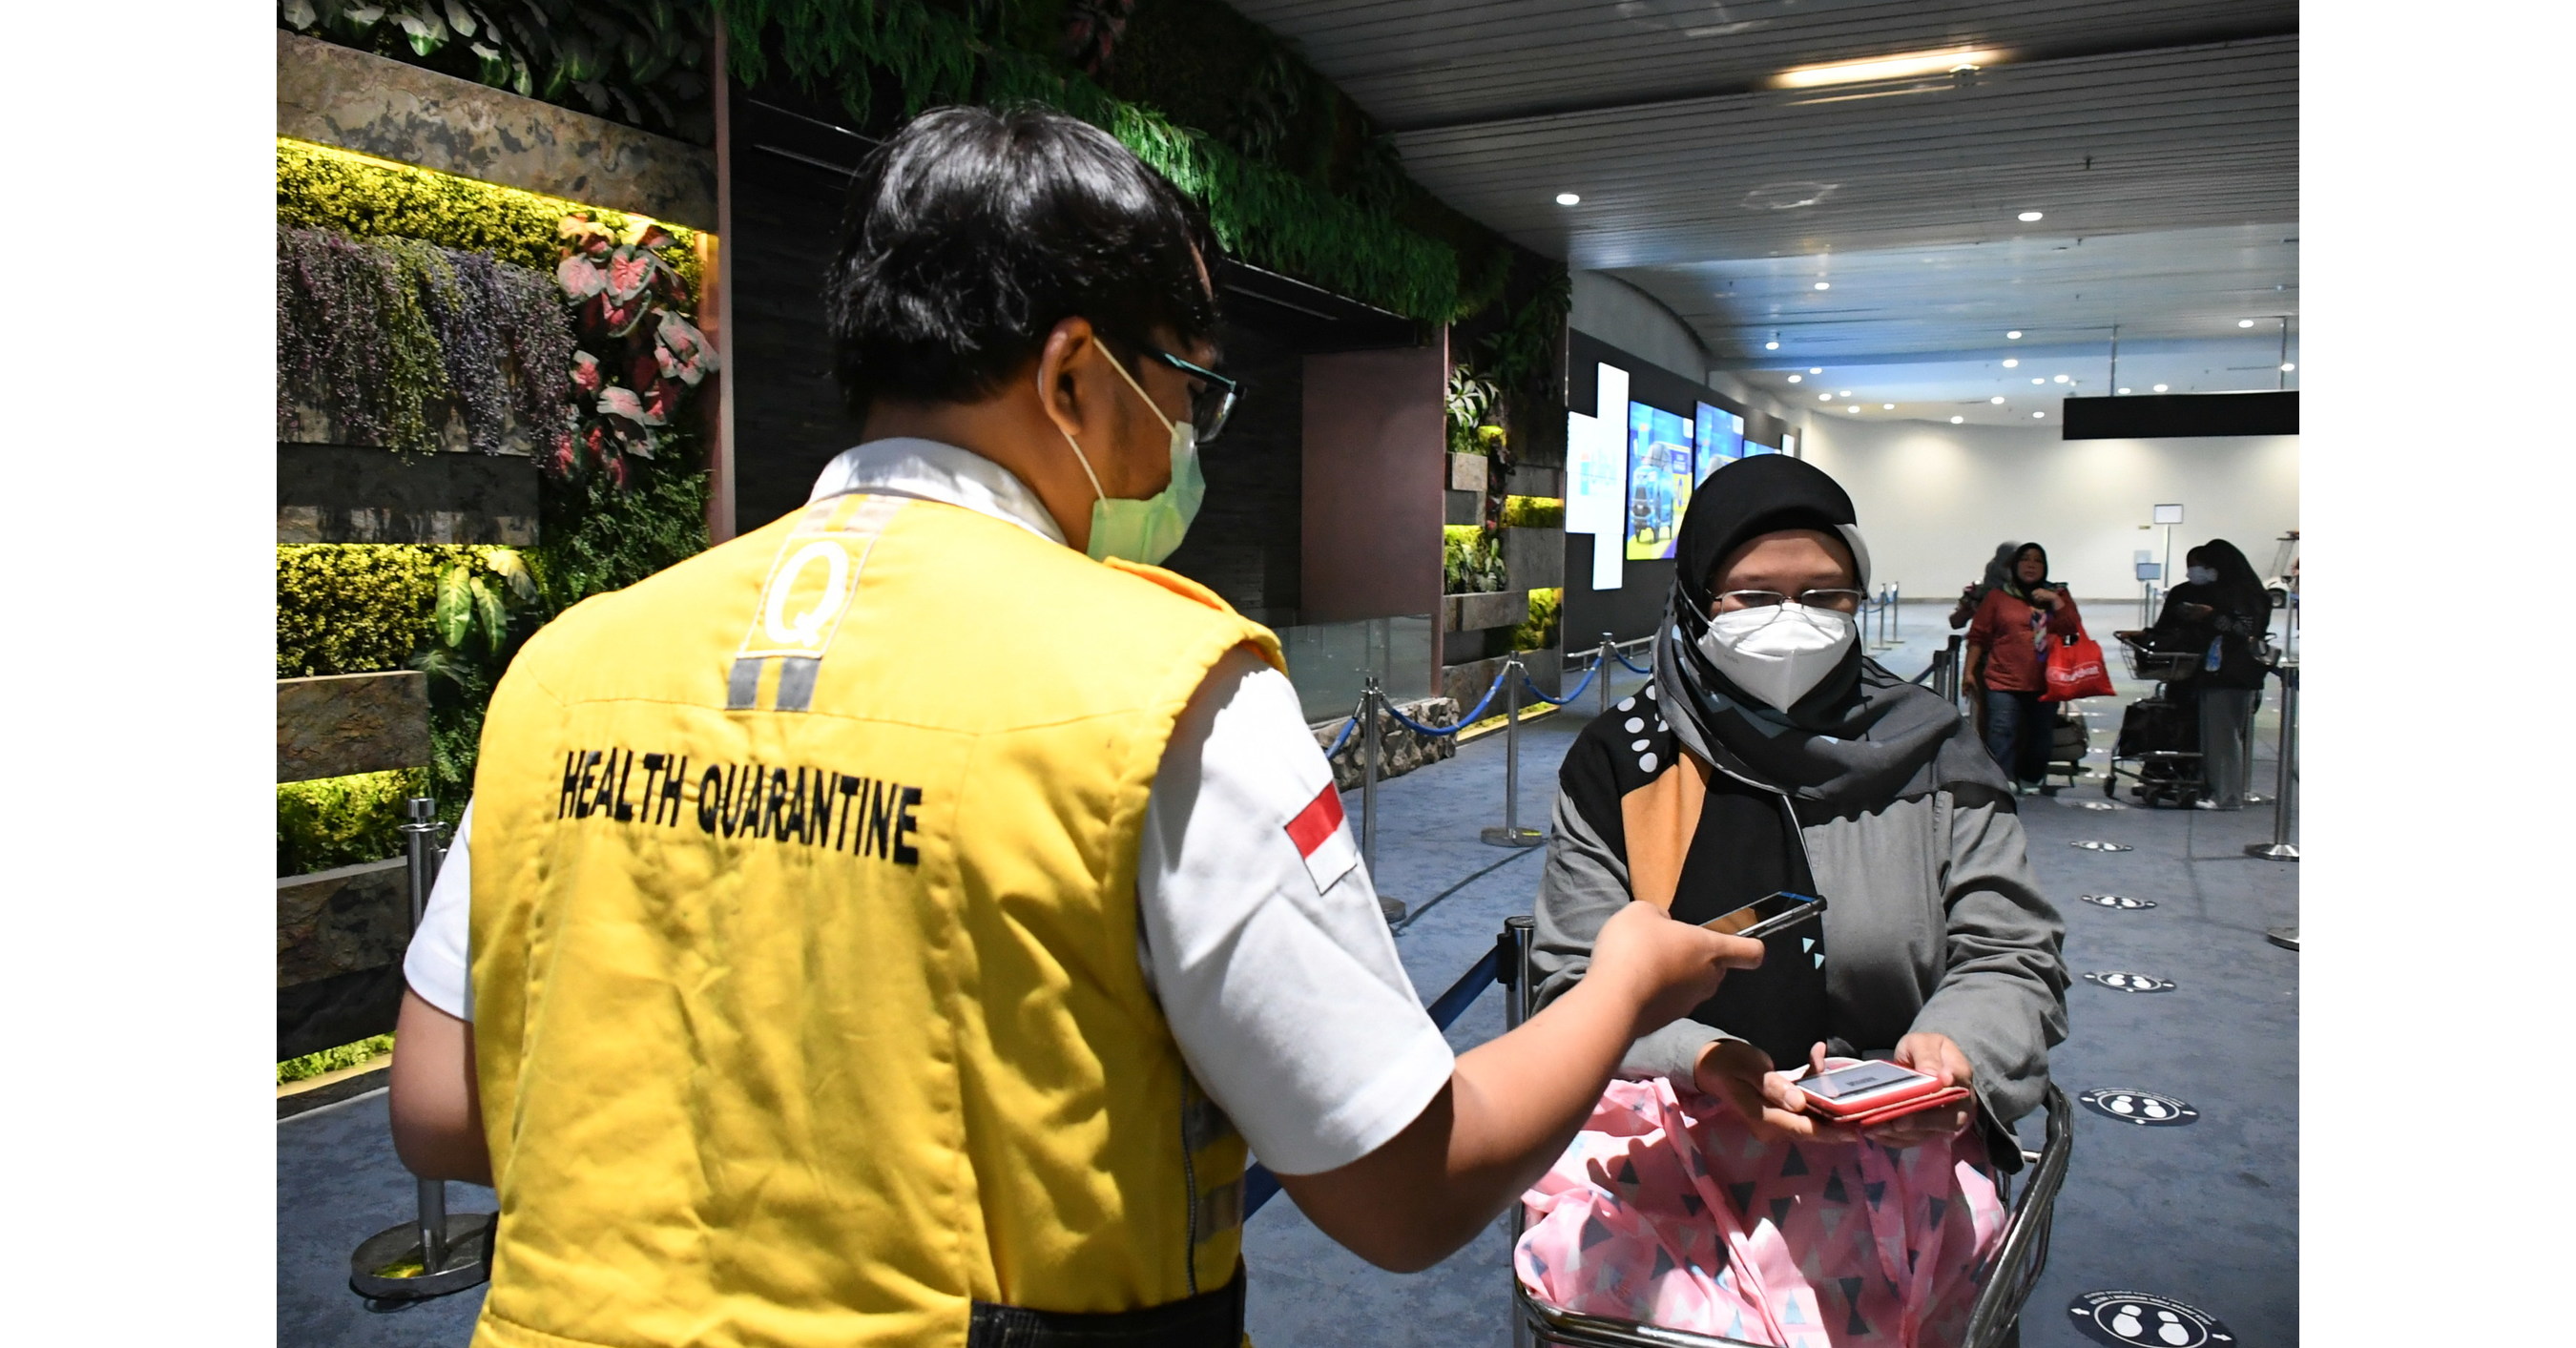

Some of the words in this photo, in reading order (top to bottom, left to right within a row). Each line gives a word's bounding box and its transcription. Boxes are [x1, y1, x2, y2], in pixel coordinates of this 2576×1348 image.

[764, 540, 849, 648] Q
[558, 747, 689, 828] HEALTH
[697, 763, 924, 865] QUARANTINE
